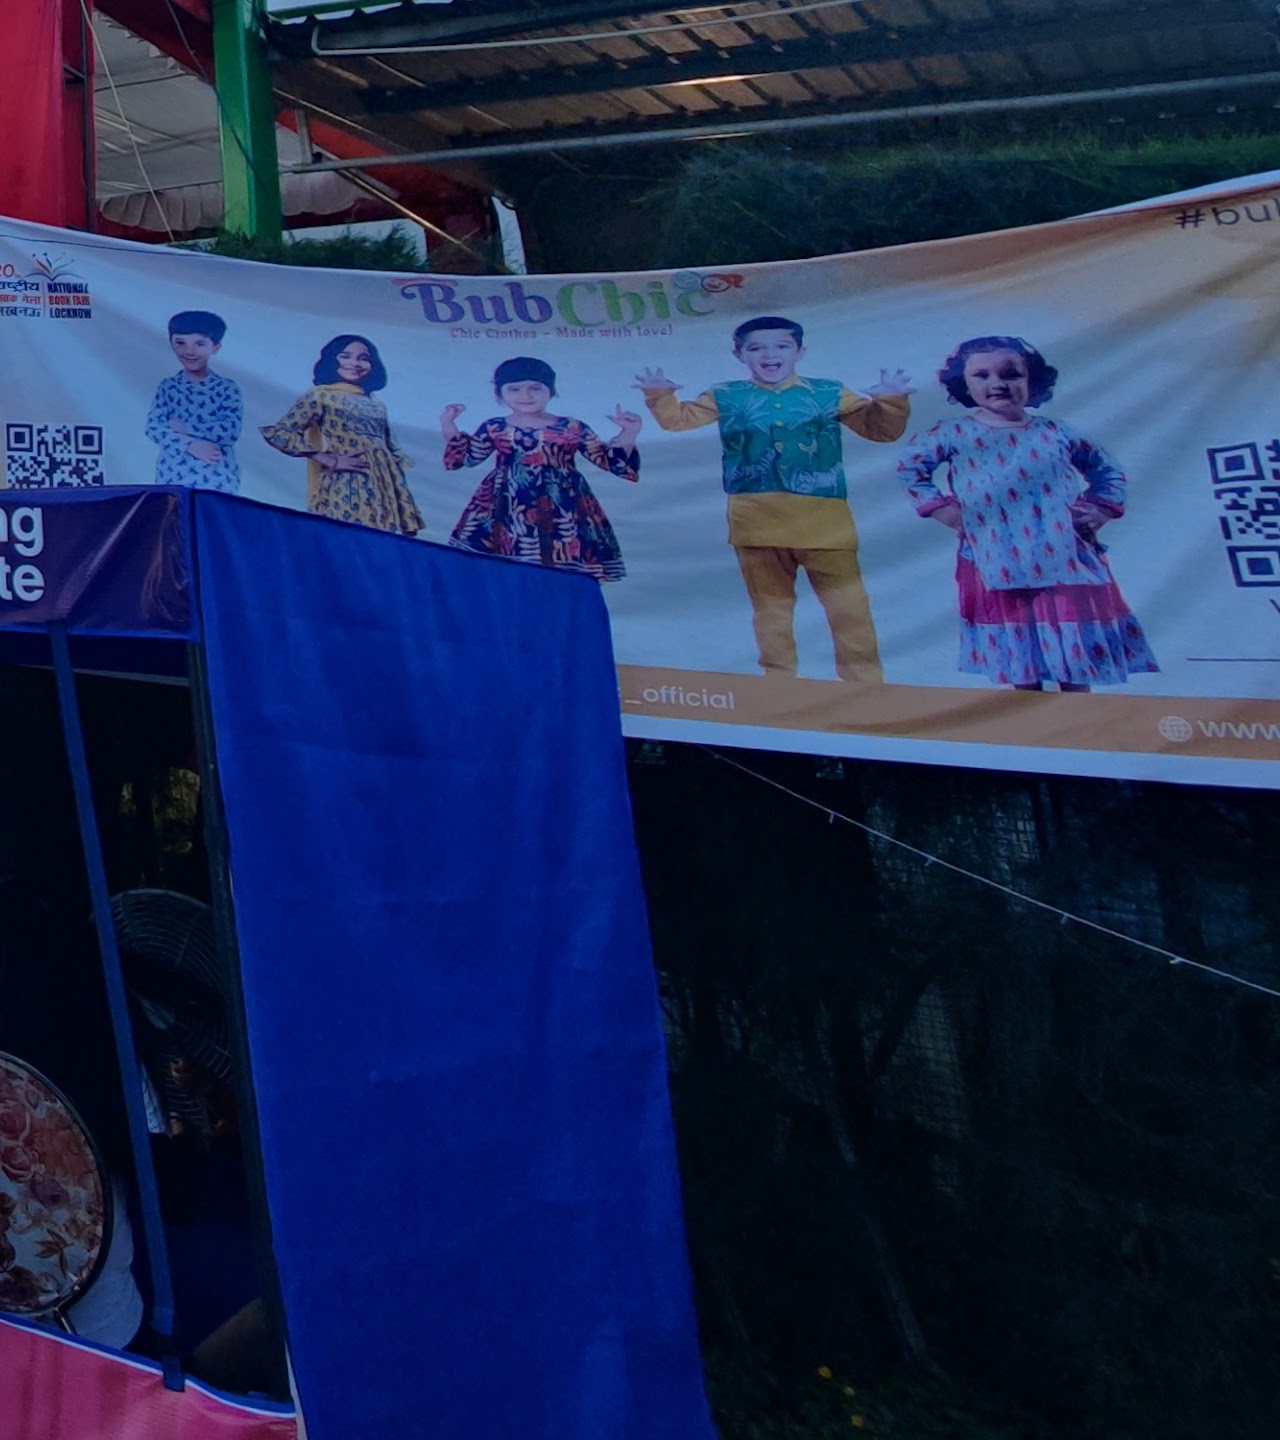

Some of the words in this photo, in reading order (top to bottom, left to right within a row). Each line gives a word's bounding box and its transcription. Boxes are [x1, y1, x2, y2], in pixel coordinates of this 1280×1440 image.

[47, 282, 89, 294] NATIONAL
[49, 295, 70, 306] BOOK
[401, 278, 716, 328] BubChic
[450, 327, 481, 339] Chic
[486, 328, 538, 340] Clothes
[556, 326, 594, 339] Made
[599, 325, 633, 339] with
